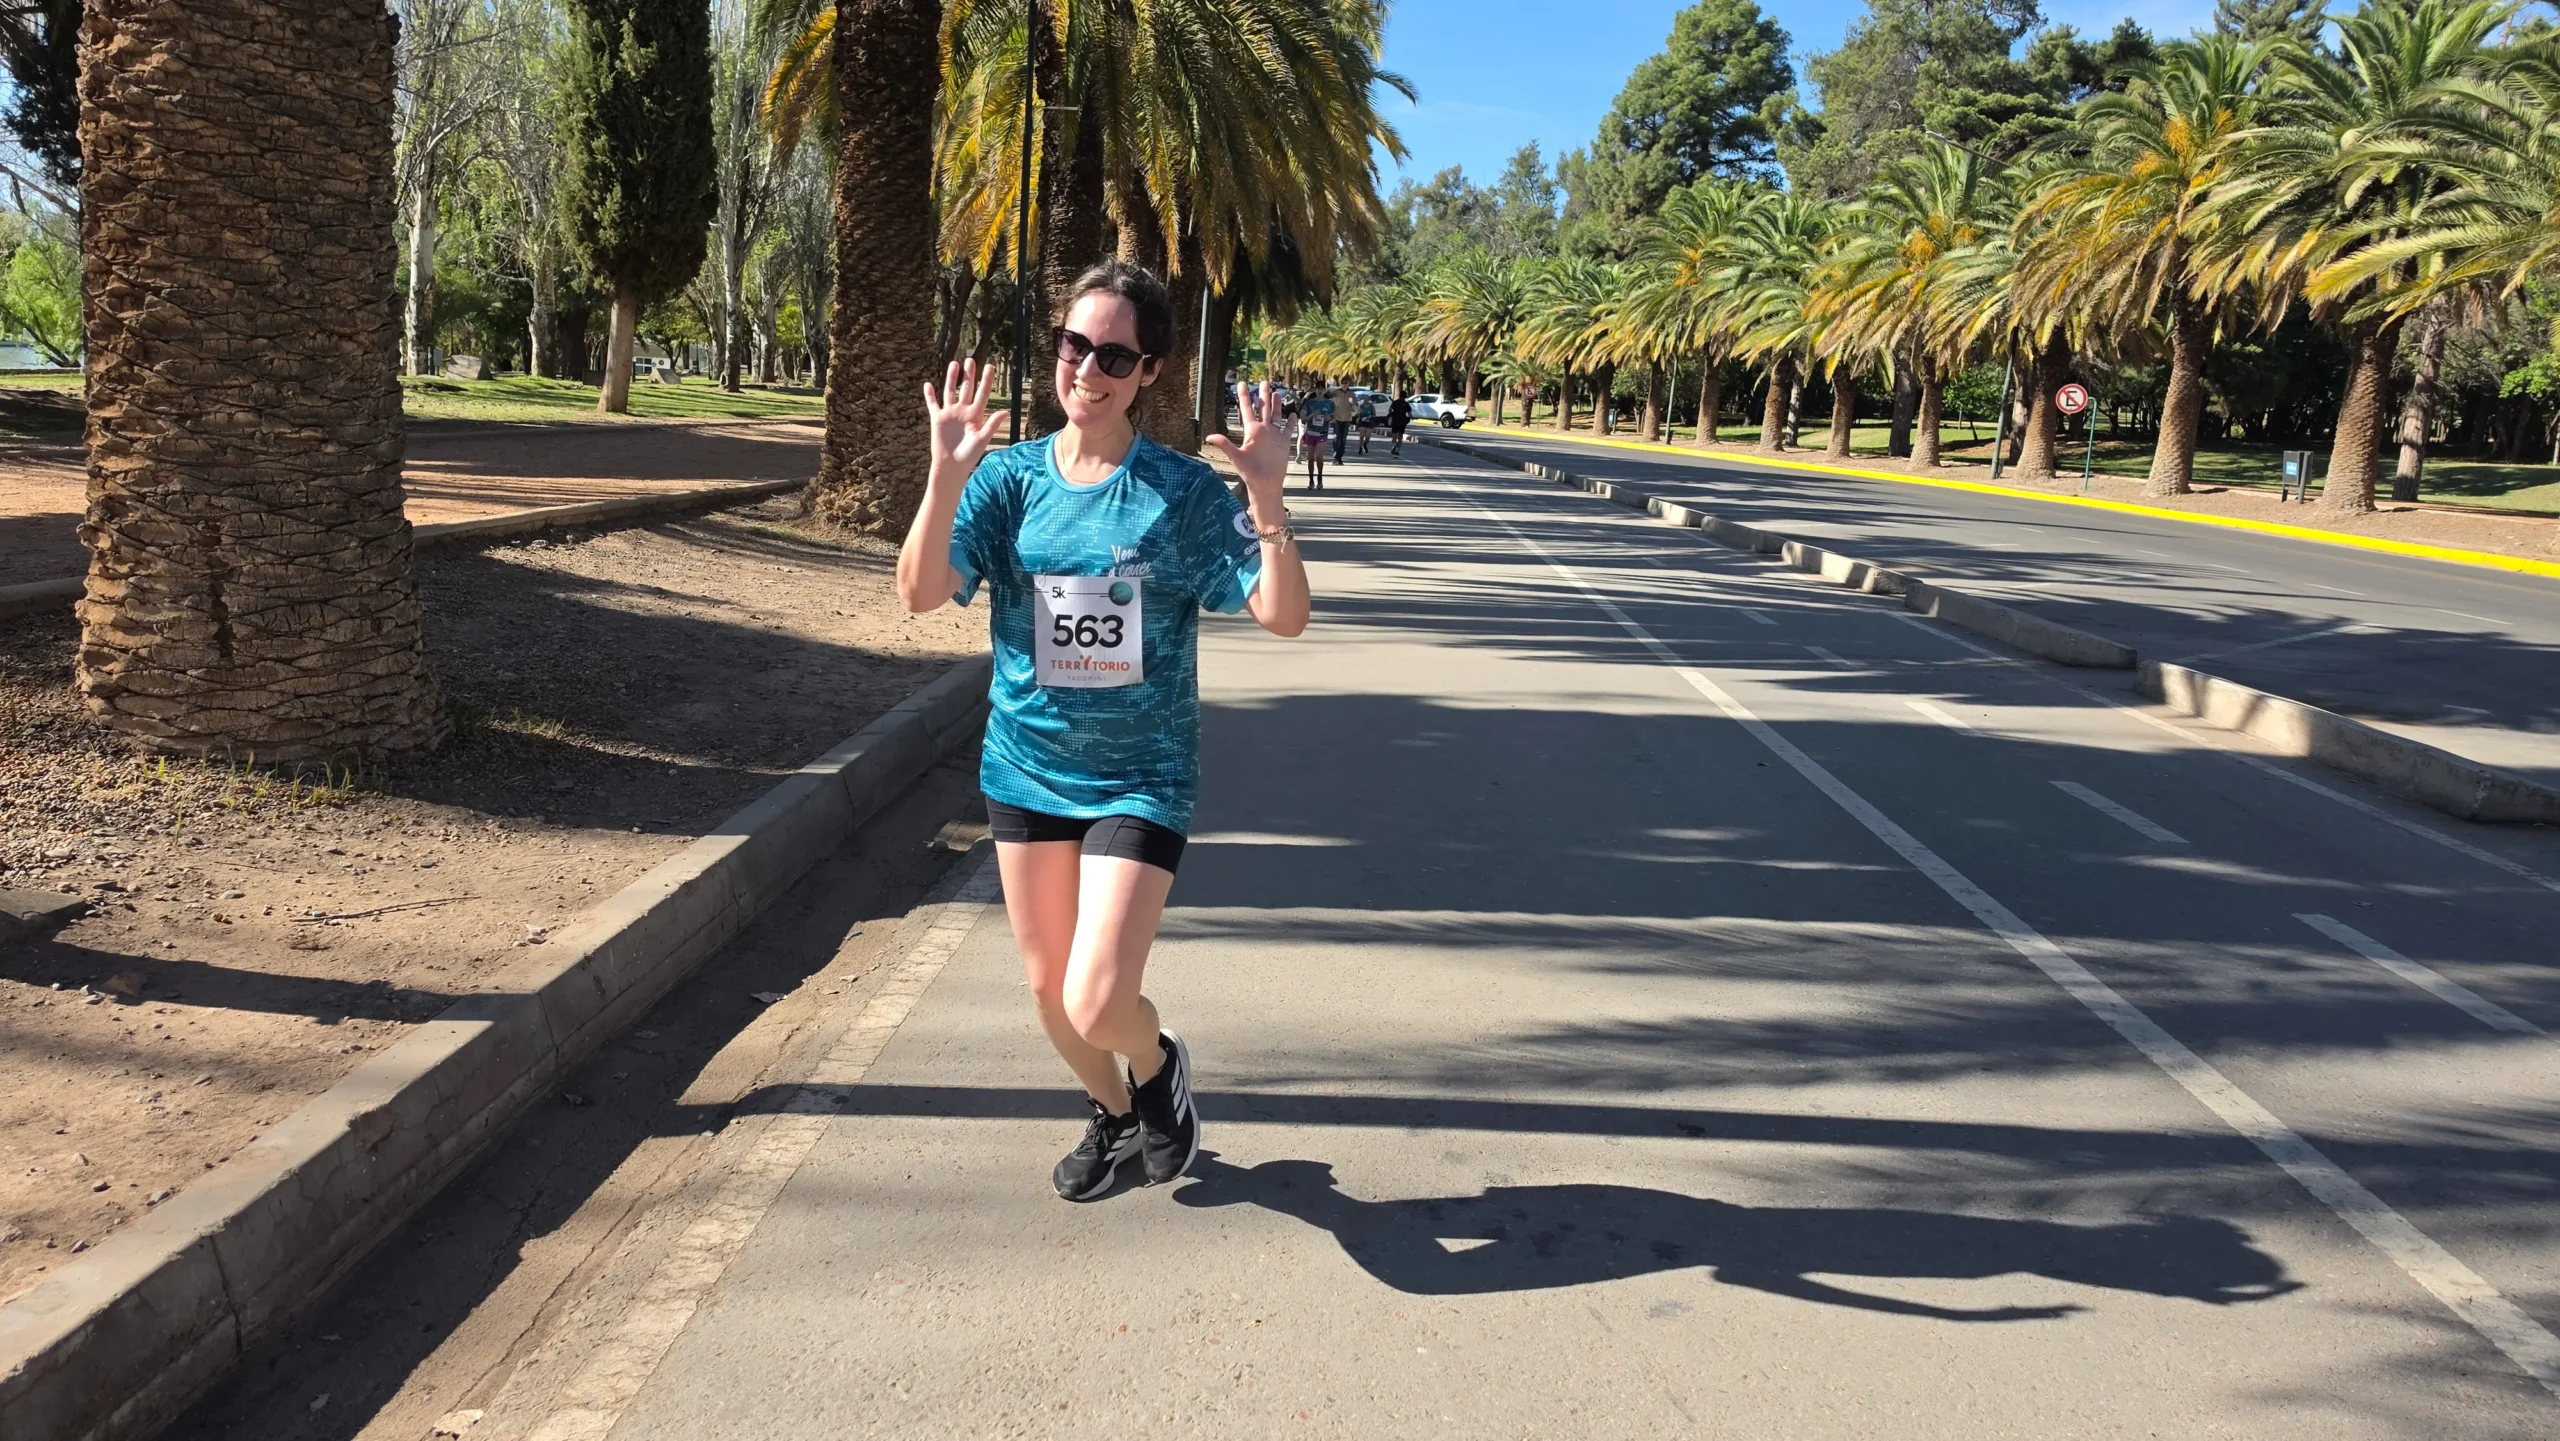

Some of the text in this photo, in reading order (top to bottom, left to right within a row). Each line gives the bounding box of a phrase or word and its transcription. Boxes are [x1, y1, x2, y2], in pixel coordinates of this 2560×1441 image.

[2066, 391, 2078, 406] E
[1052, 586, 1066, 599] 5k
[1051, 614, 1124, 648] 563
[1050, 655, 1130, 671] TERRITORIO
